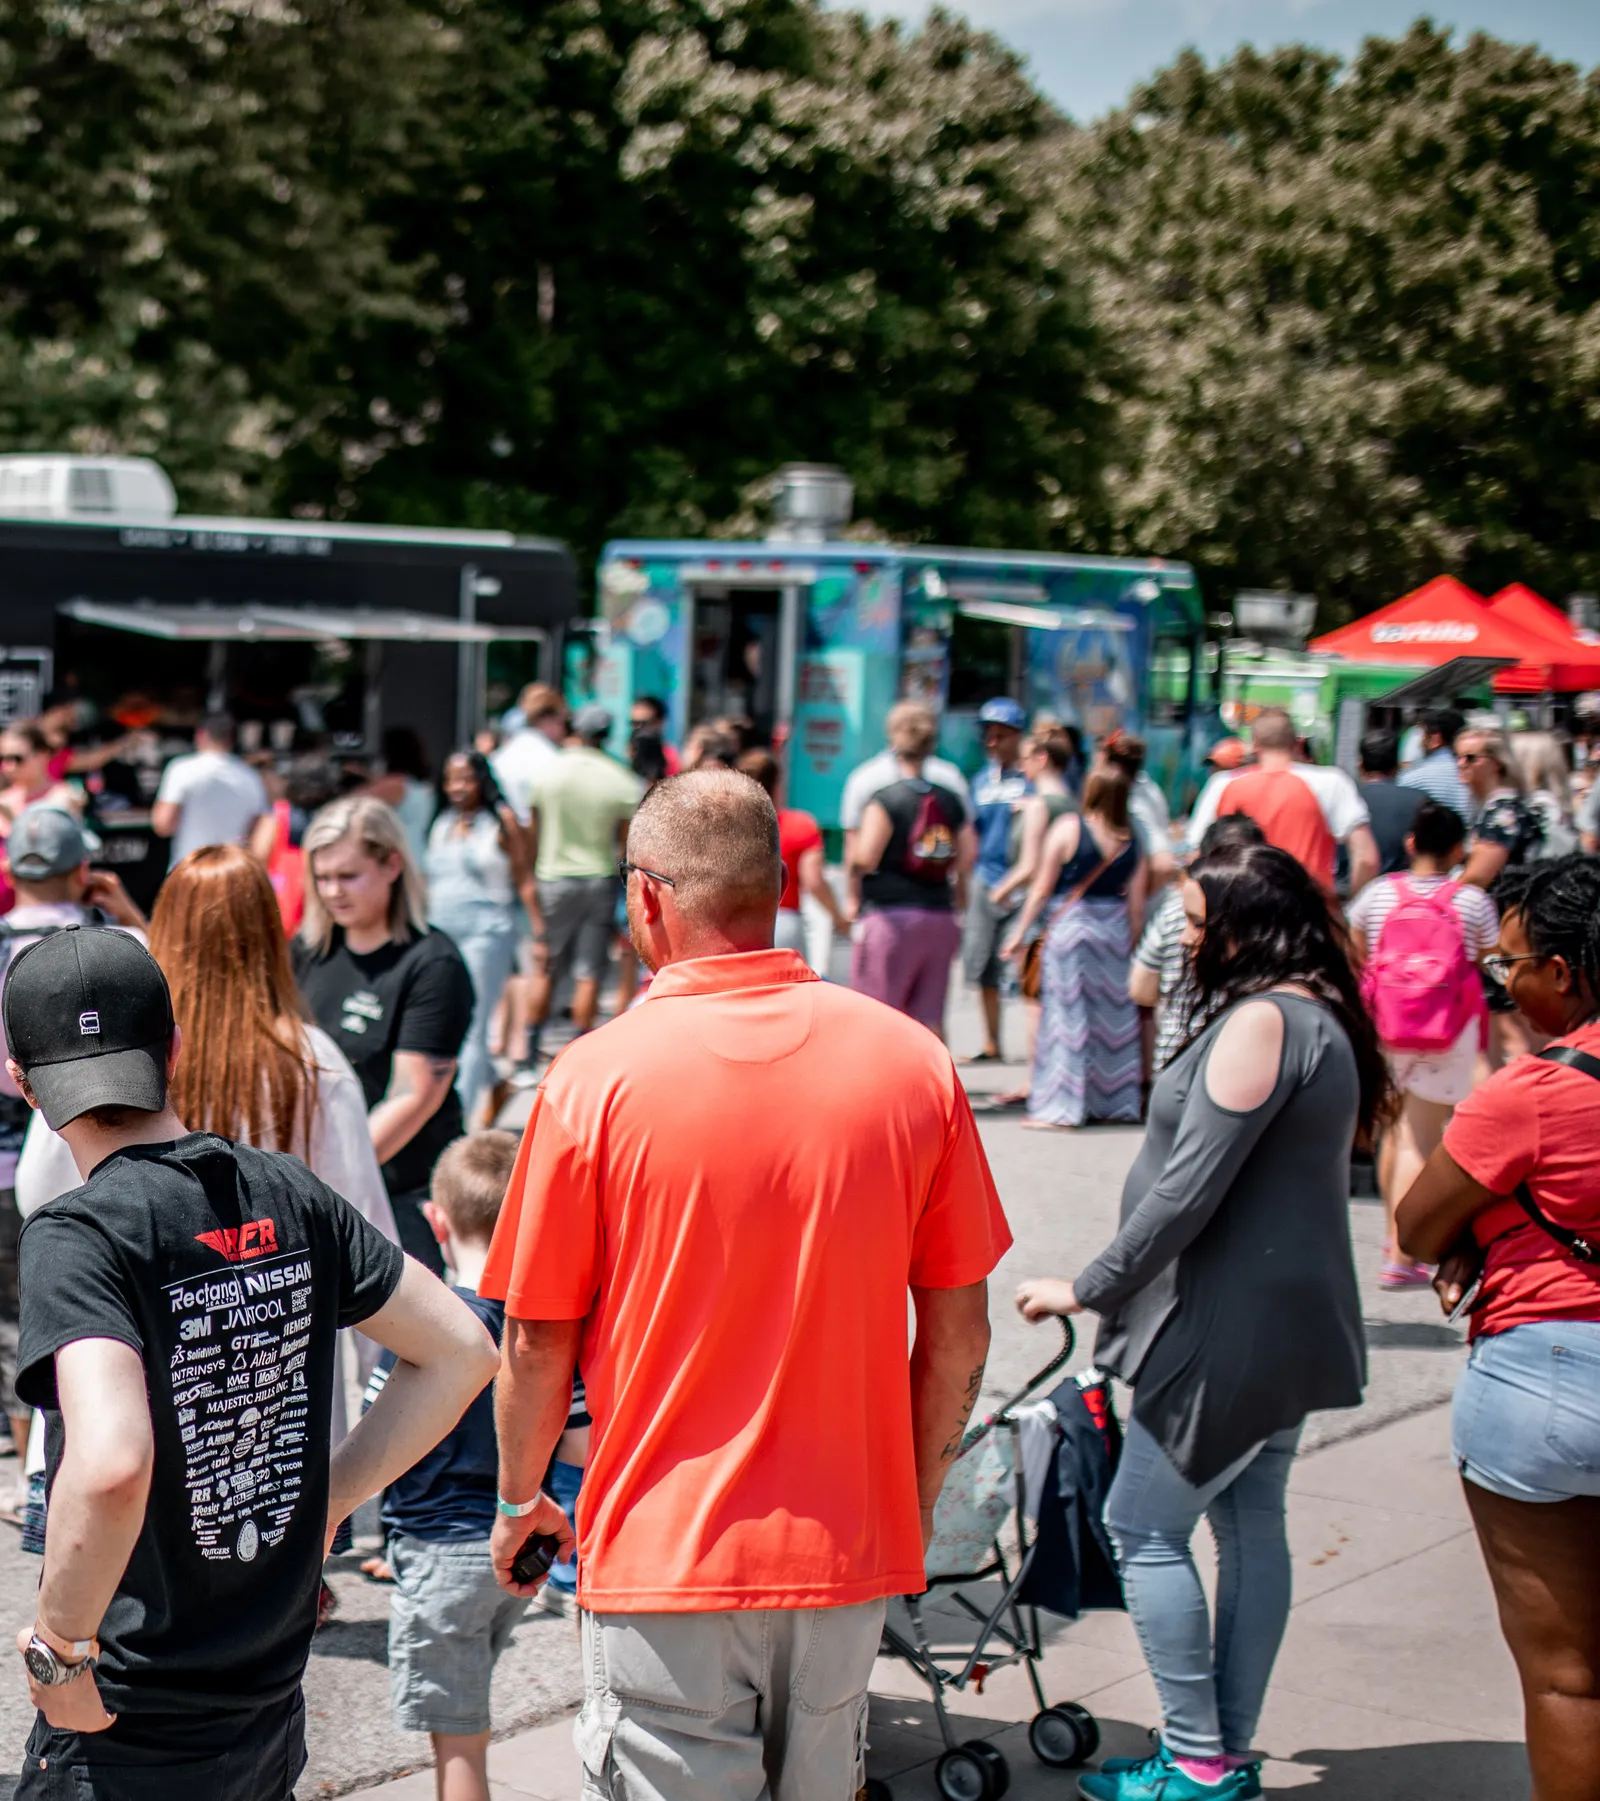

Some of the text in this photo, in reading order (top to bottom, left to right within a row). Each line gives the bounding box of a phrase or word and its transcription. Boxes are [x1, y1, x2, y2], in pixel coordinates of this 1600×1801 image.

[244, 1261, 312, 1296] NISSAN
[206, 1297, 235, 1307] HEALTH
[180, 1316, 212, 1340] 3M
[283, 1314, 312, 1337] SIEMENS
[250, 1348, 277, 1368] Altair
[171, 1360, 226, 1383] INTRINSYS
[206, 1393, 254, 1414] MAJESTIC
[261, 1526, 286, 1542] RUTGERS
[201, 1547, 230, 1557] RUTGERS
